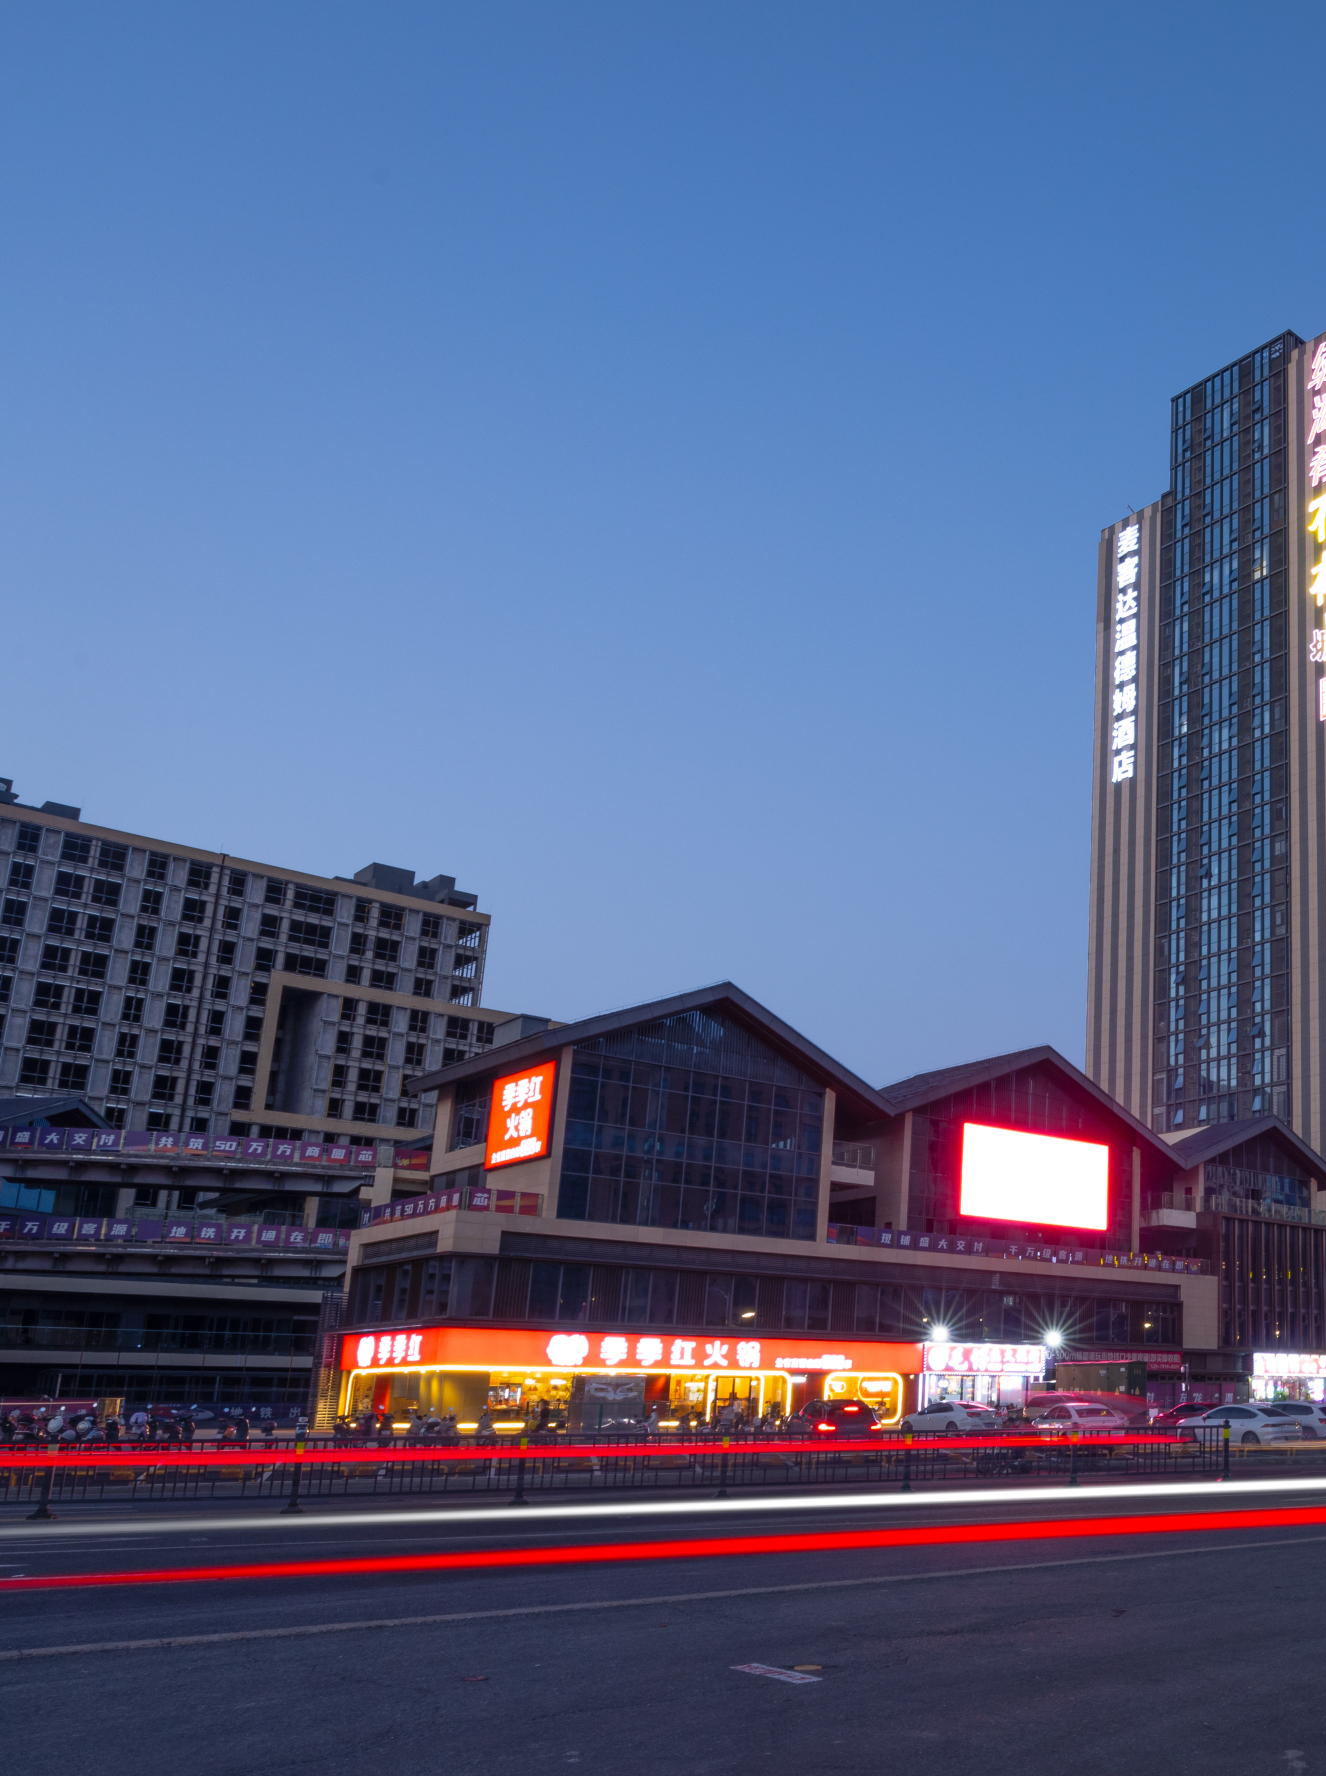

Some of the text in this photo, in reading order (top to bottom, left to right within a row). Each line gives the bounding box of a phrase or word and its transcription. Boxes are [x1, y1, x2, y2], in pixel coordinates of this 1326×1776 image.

[1111, 523, 1139, 784] 麦客达温德姆酒店
[502, 1076, 543, 1111] 季季红
[504, 1108, 533, 1141] 火锅
[169, 1226, 334, 1244] 地铁开通在即
[880, 1232, 984, 1254] 现铺盛大交付
[377, 1333, 423, 1365] 季季红
[599, 1336, 762, 1369] 季季红火锅
